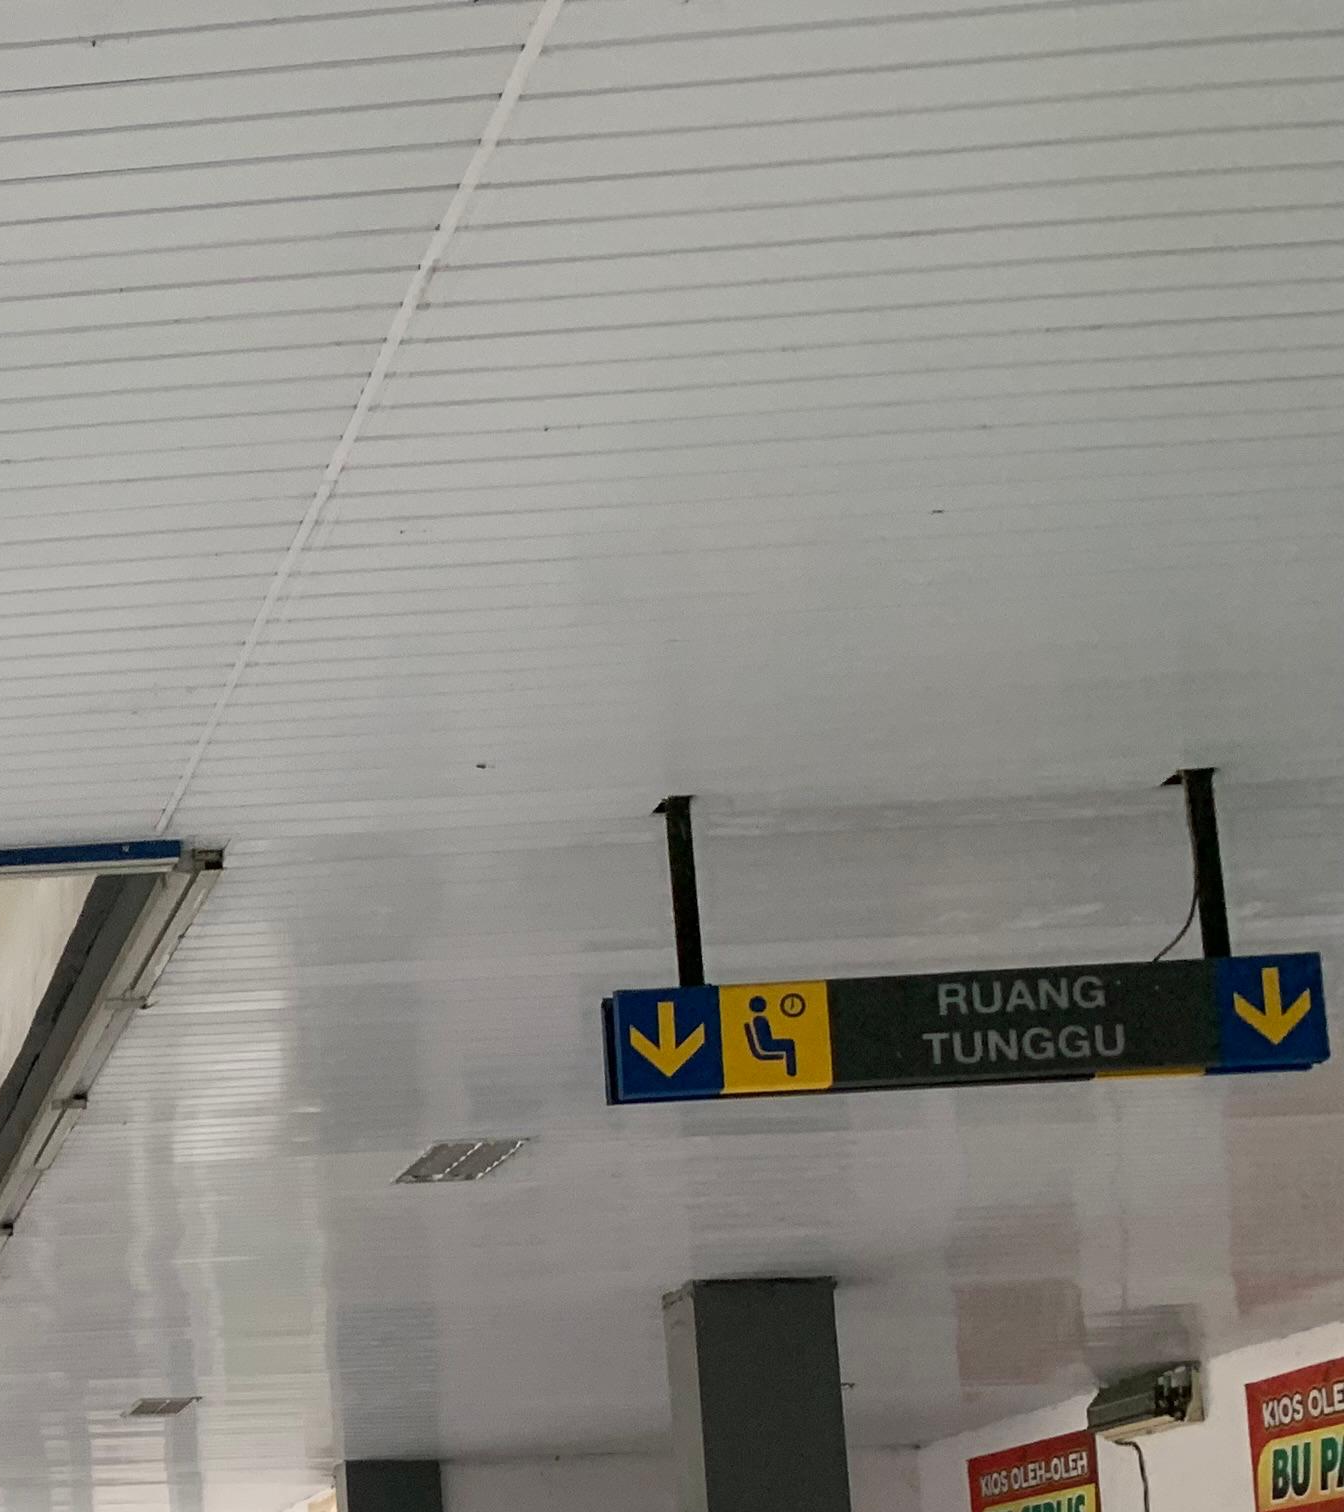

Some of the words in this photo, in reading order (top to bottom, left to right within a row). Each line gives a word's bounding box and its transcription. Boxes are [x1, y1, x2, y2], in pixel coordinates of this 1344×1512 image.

[937, 975, 1107, 1016] RUANG
[921, 1023, 1126, 1065] TUNGGU
[1262, 1393, 1304, 1428] KIOS
[980, 1470, 1009, 1498] KIOS
[1010, 1451, 1088, 1490] OLEH-OLEH
[1272, 1441, 1312, 1500] BU
